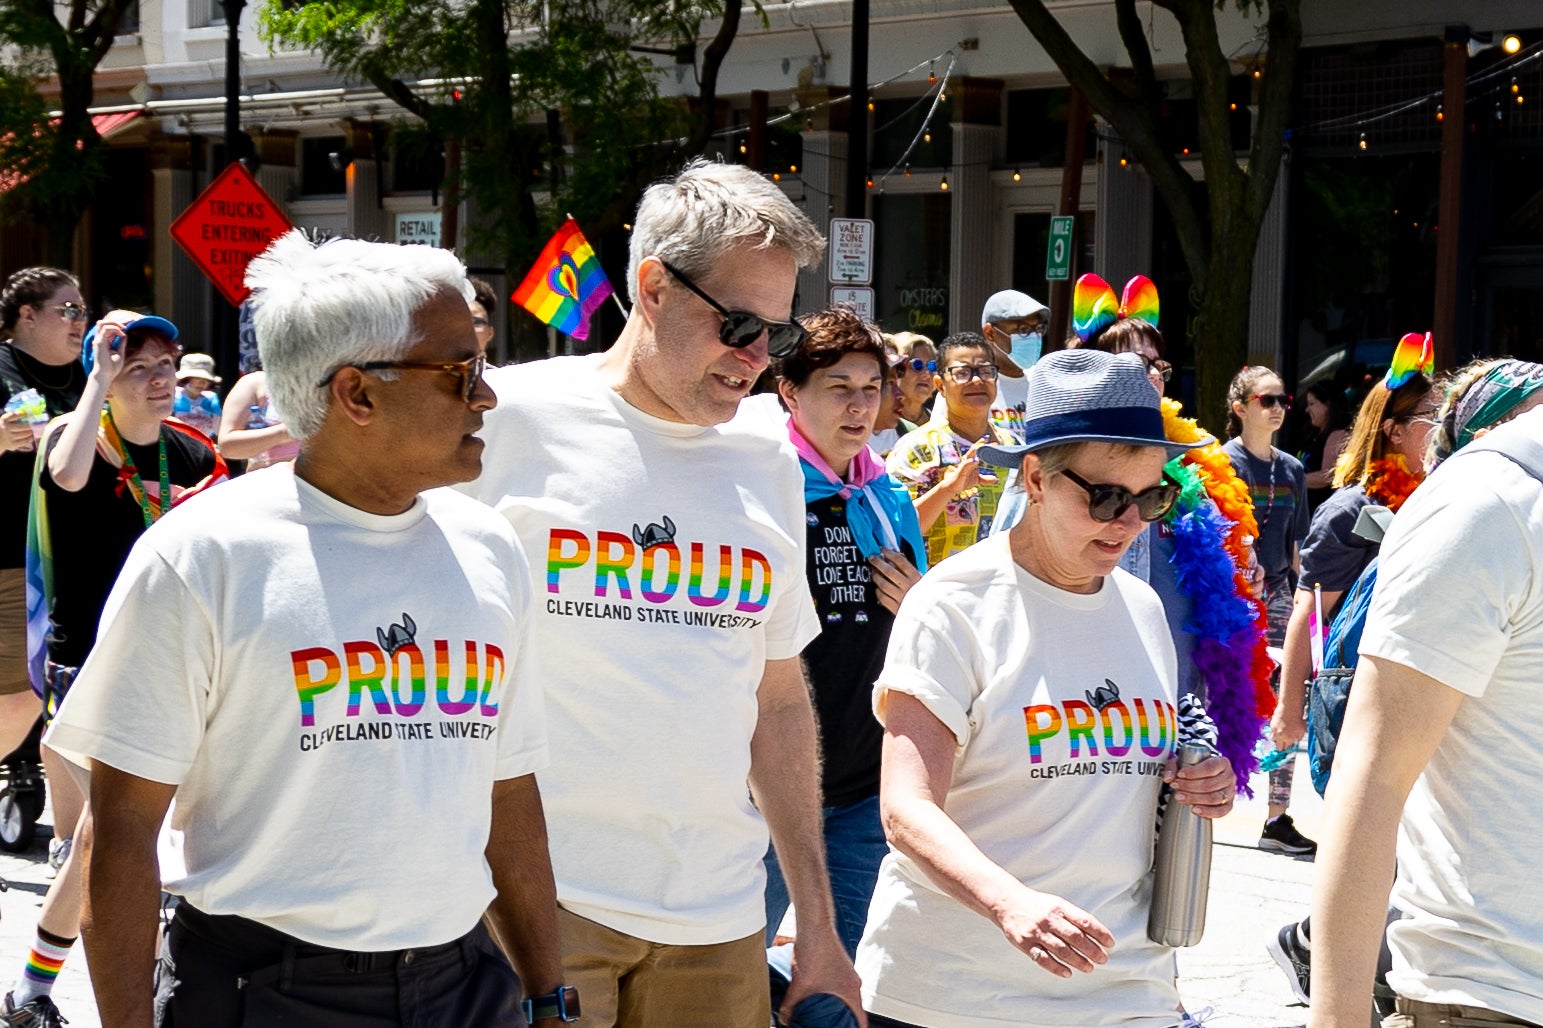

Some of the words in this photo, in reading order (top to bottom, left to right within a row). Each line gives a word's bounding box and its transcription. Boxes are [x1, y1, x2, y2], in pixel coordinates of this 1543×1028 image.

[208, 200, 265, 219] TRUCKS
[201, 223, 271, 243] ENTERING
[399, 220, 437, 236] RETAIL
[839, 224, 865, 234] VALET
[1053, 220, 1070, 235] MILE
[839, 233, 864, 243] ZONE
[209, 248, 256, 265] EXITIN
[900, 288, 945, 307] OYSTERS
[824, 526, 851, 543] DON
[814, 545, 857, 565] FORGET
[547, 528, 772, 613] PROUD
[830, 585, 865, 604] OTHER
[546, 599, 632, 621] CLEVELAND
[637, 607, 681, 624] STATE
[290, 639, 505, 727] PROUD
[300, 721, 393, 752] CLEVELAND
[1030, 762, 1097, 779] CLEVELAND
